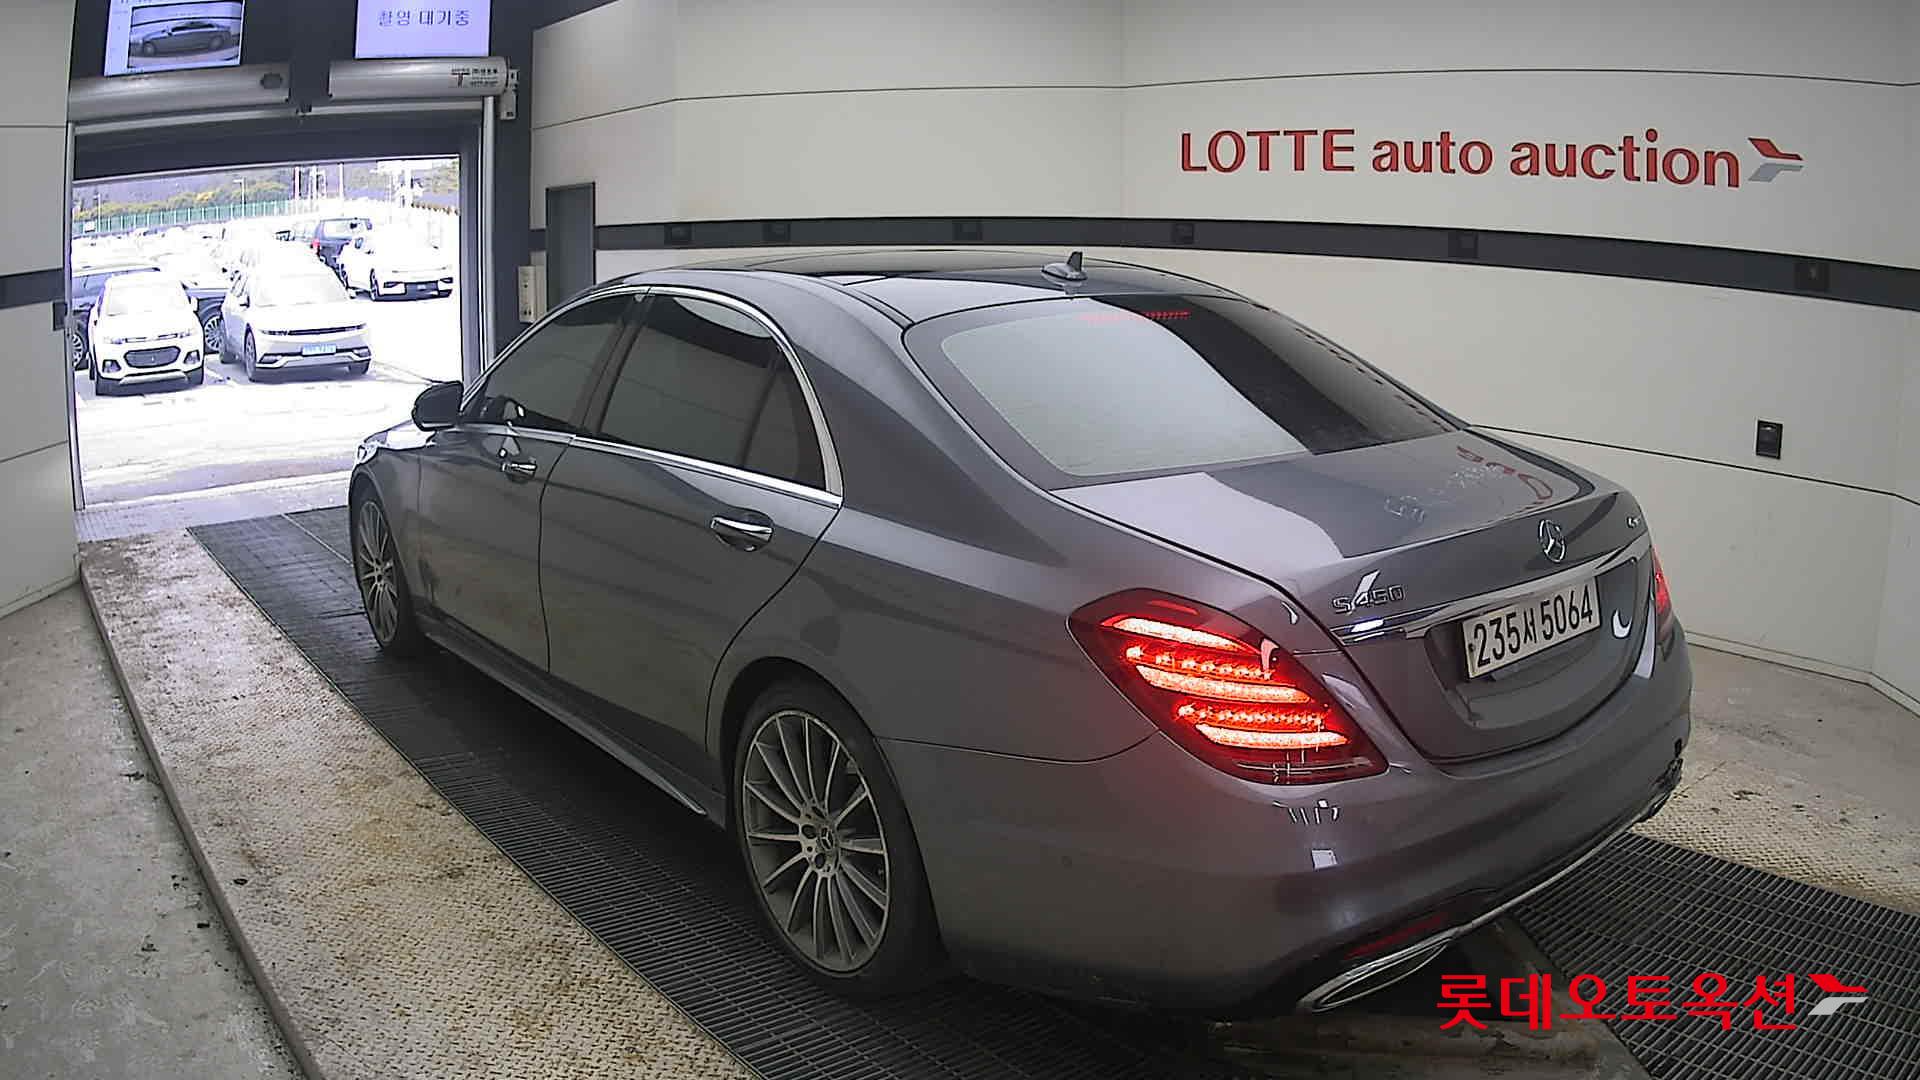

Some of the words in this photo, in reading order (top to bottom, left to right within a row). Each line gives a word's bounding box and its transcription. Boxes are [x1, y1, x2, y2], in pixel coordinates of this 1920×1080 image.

[419, 9, 469, 27] 대기중
[1180, 129, 1356, 172] LOTTE
[1371, 130, 1494, 175] auto
[1509, 128, 1741, 188] auction
[1332, 584, 1405, 614] S450
